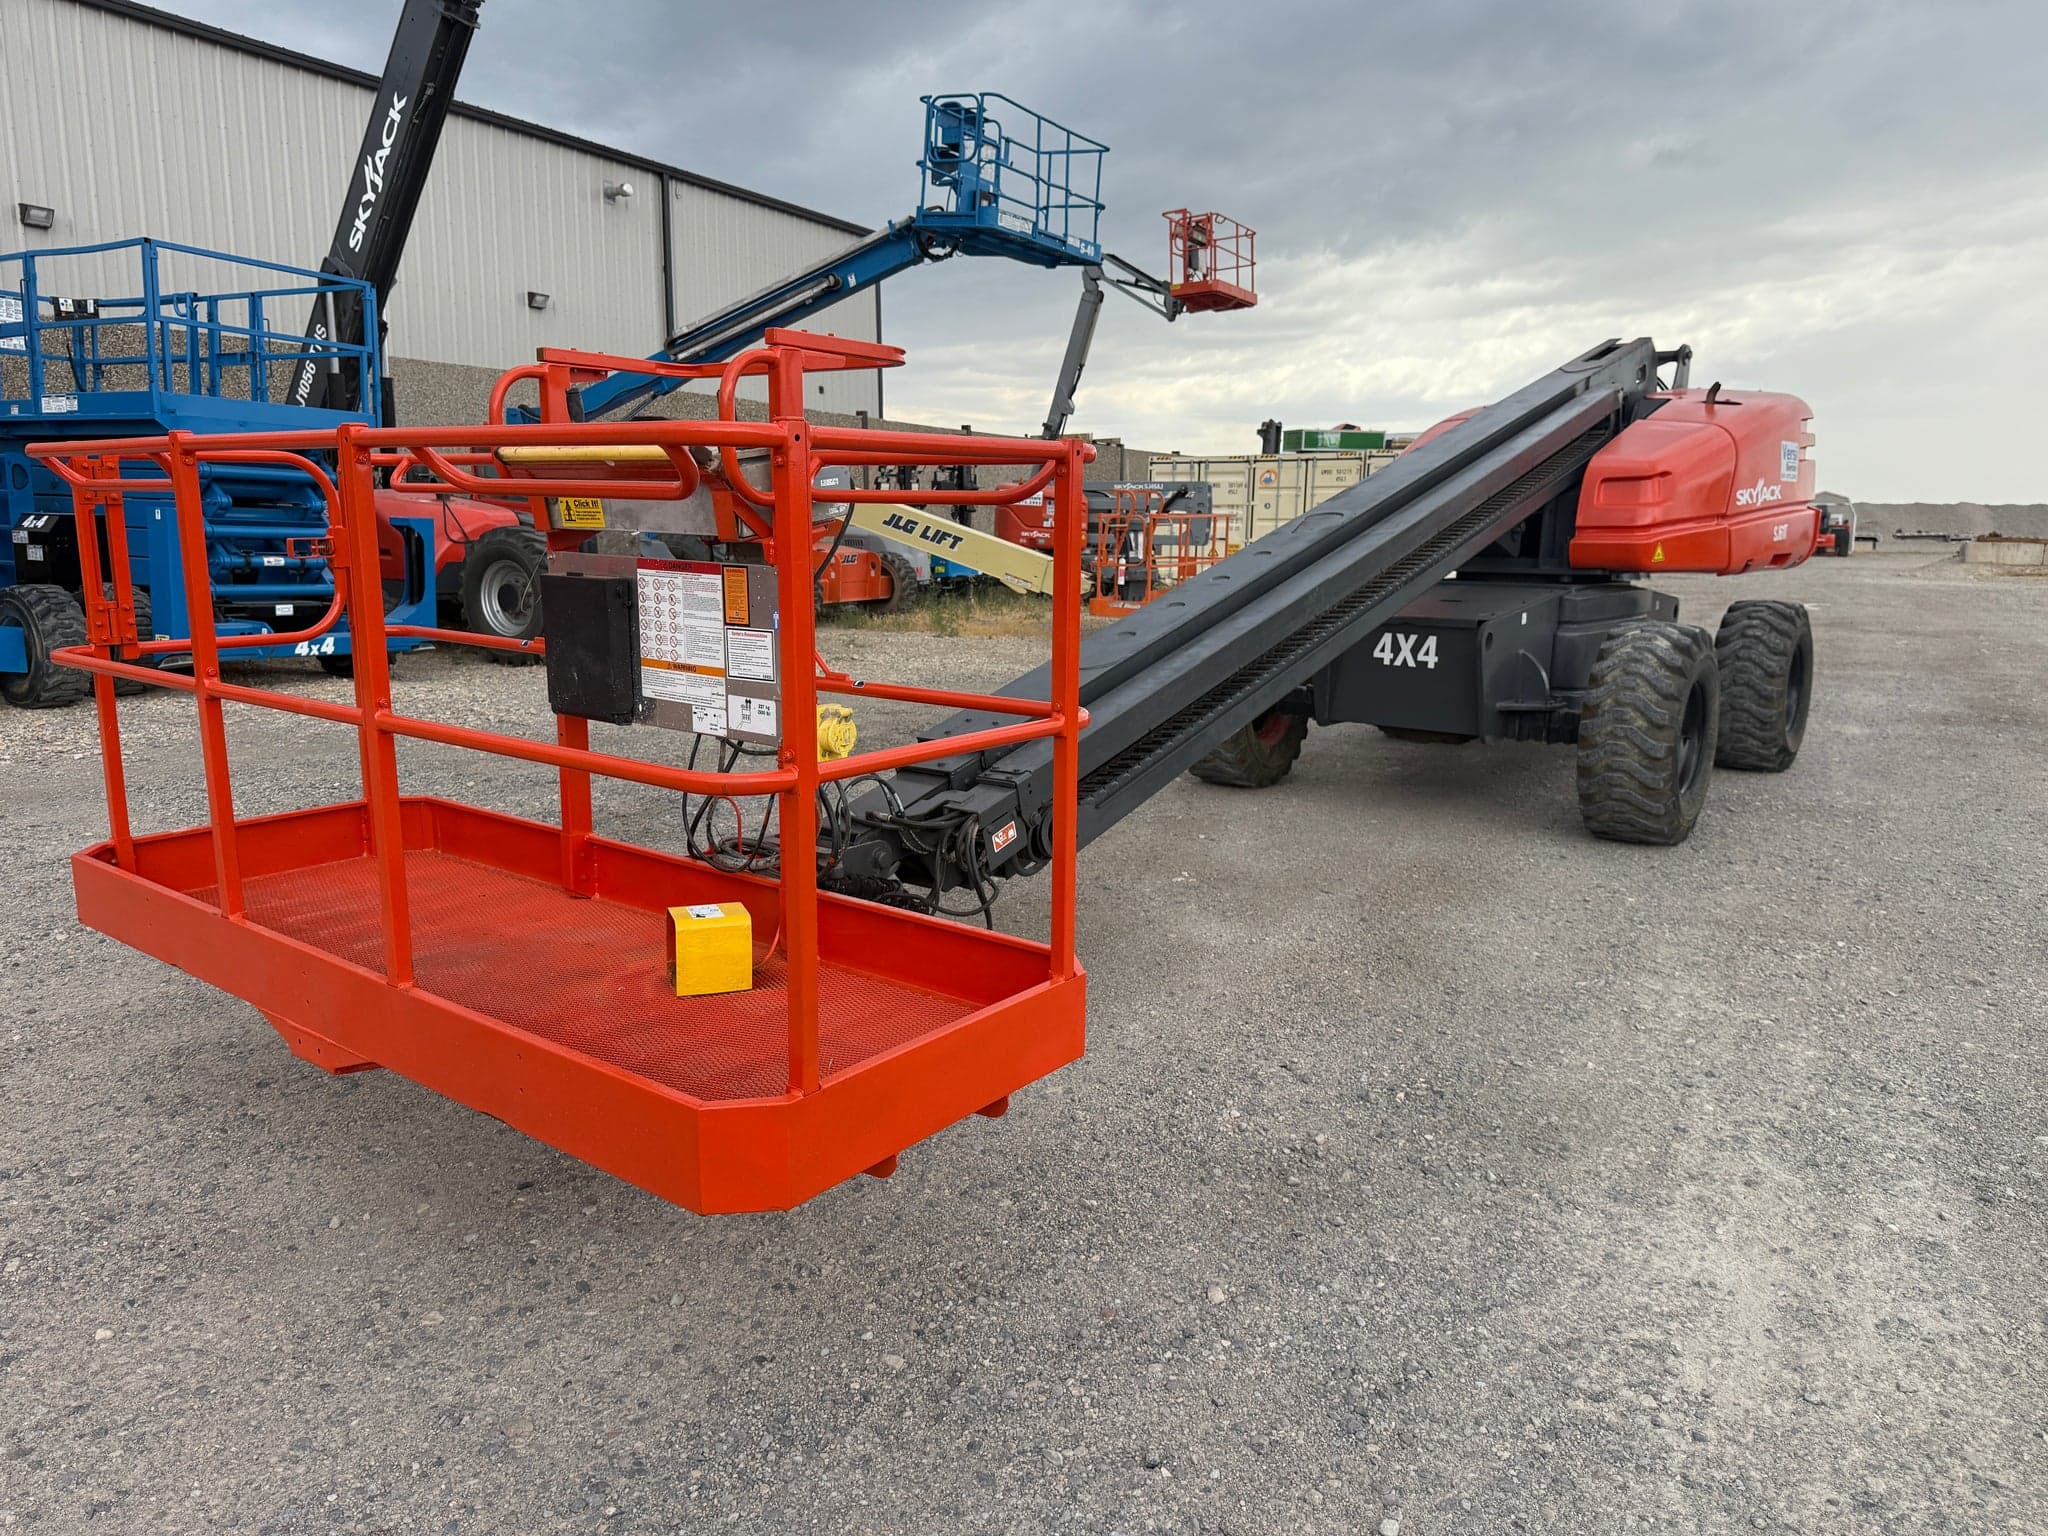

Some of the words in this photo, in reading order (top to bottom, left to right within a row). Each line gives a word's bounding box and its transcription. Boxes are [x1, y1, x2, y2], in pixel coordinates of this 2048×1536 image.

[349, 91, 408, 252] SKYJACK
[1735, 478, 1782, 507] SKYJACK
[574, 499, 589, 507] Click
[22, 514, 49, 528] 4x4
[882, 513, 919, 535] JLG
[919, 525, 964, 550] LIFT
[841, 554, 857, 563] JLG
[294, 637, 335, 656] 4x4
[1373, 632, 1439, 669] 4X4
[672, 664, 697, 673] WARNING
